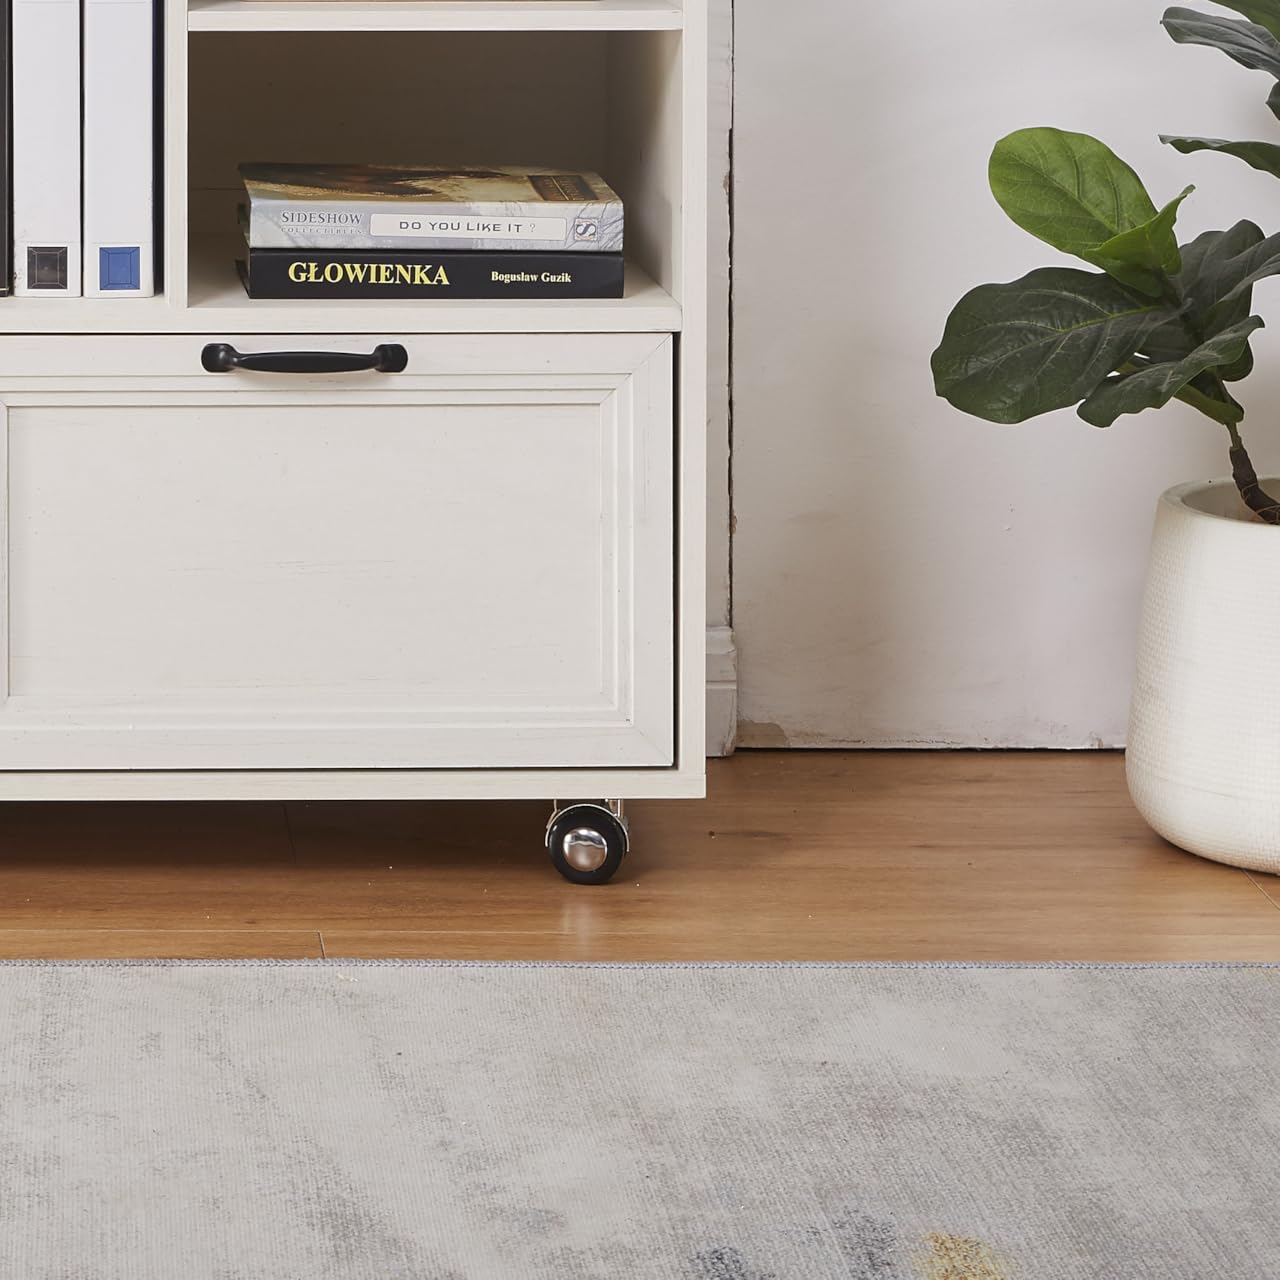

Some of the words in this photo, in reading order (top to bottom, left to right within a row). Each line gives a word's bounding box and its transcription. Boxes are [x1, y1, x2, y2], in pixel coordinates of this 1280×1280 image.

[281, 212, 363, 225] SIDESHOW
[399, 221, 422, 230] DO
[429, 222, 461, 231] YOU
[466, 222, 502, 232] LIKE
[507, 223, 523, 233] IT
[288, 261, 450, 285] GŁOWIENKA
[540, 272, 572, 283] Guzik
